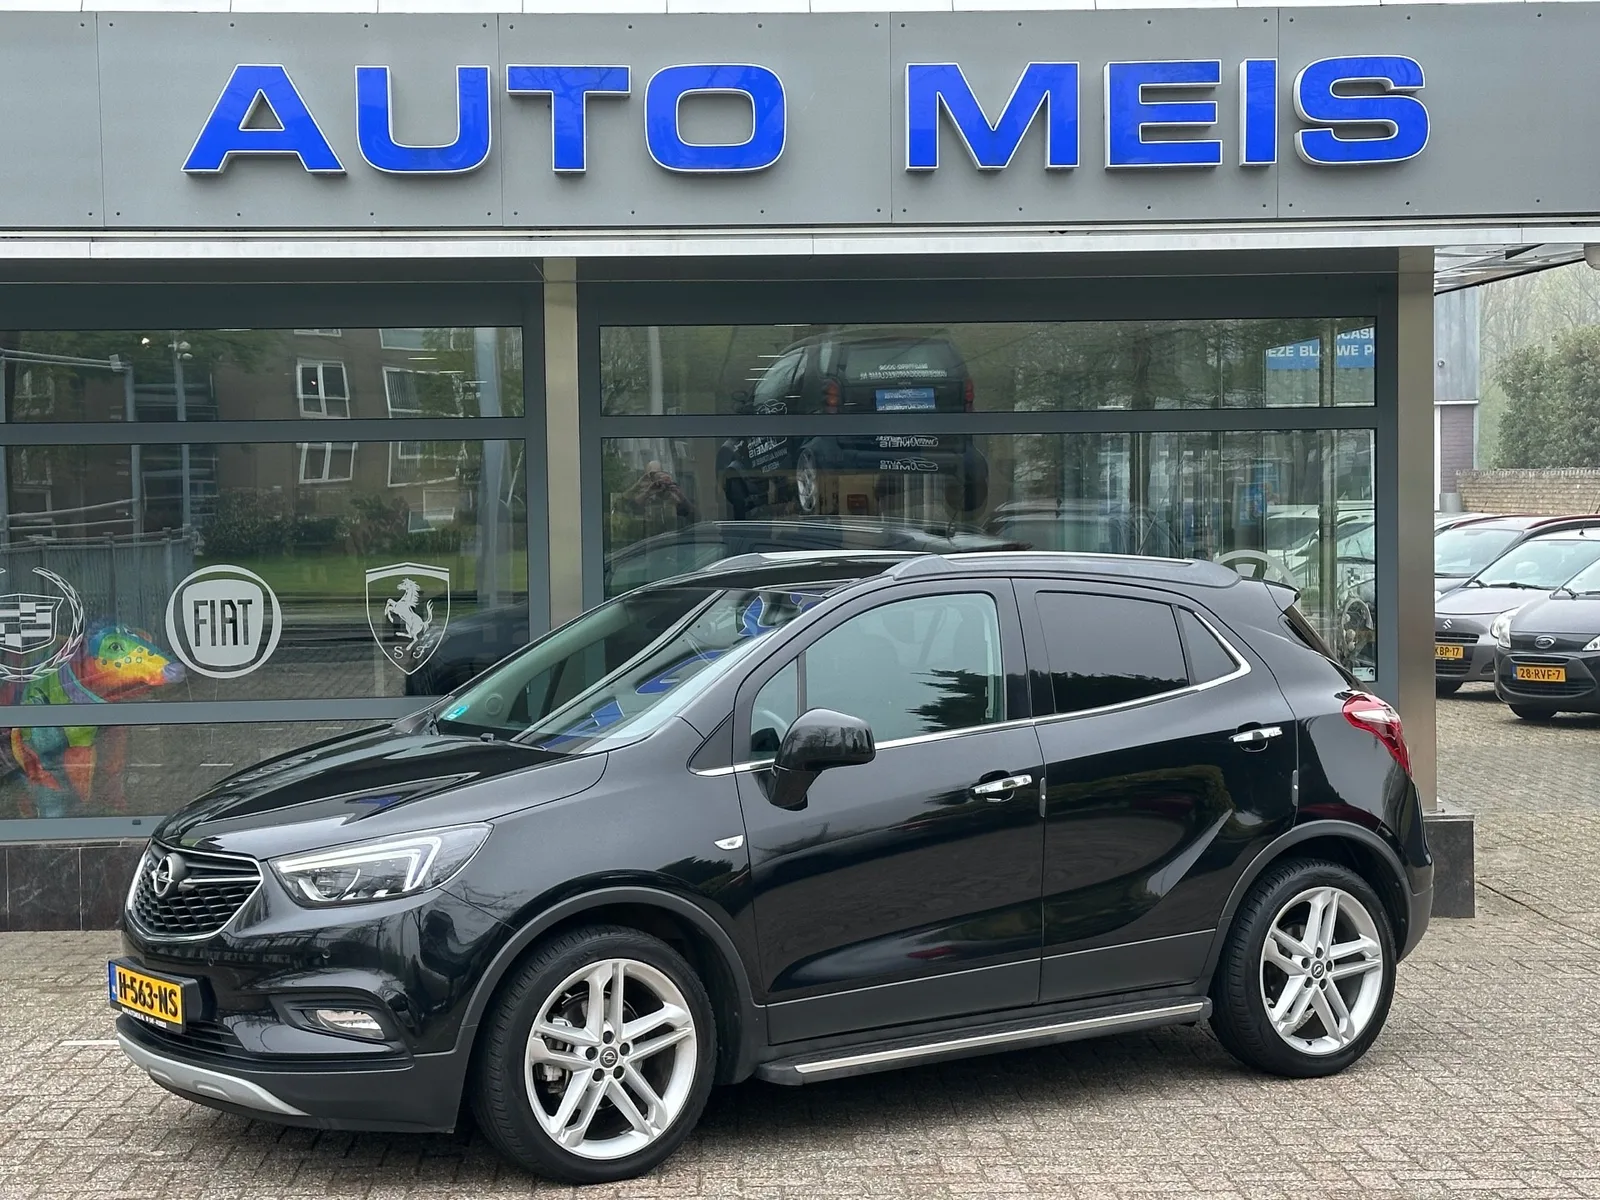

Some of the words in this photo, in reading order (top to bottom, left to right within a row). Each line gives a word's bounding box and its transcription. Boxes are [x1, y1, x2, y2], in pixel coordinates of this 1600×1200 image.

[180, 62, 787, 174] AUTO
[905, 54, 1430, 171] MEIS
[1266, 345, 1294, 357] EZE
[193, 599, 253, 647] FIAT
[393, 645, 403, 659] S
[1519, 668, 1561, 680] 28-RVF-7
[118, 971, 179, 1018] H-563-NS
